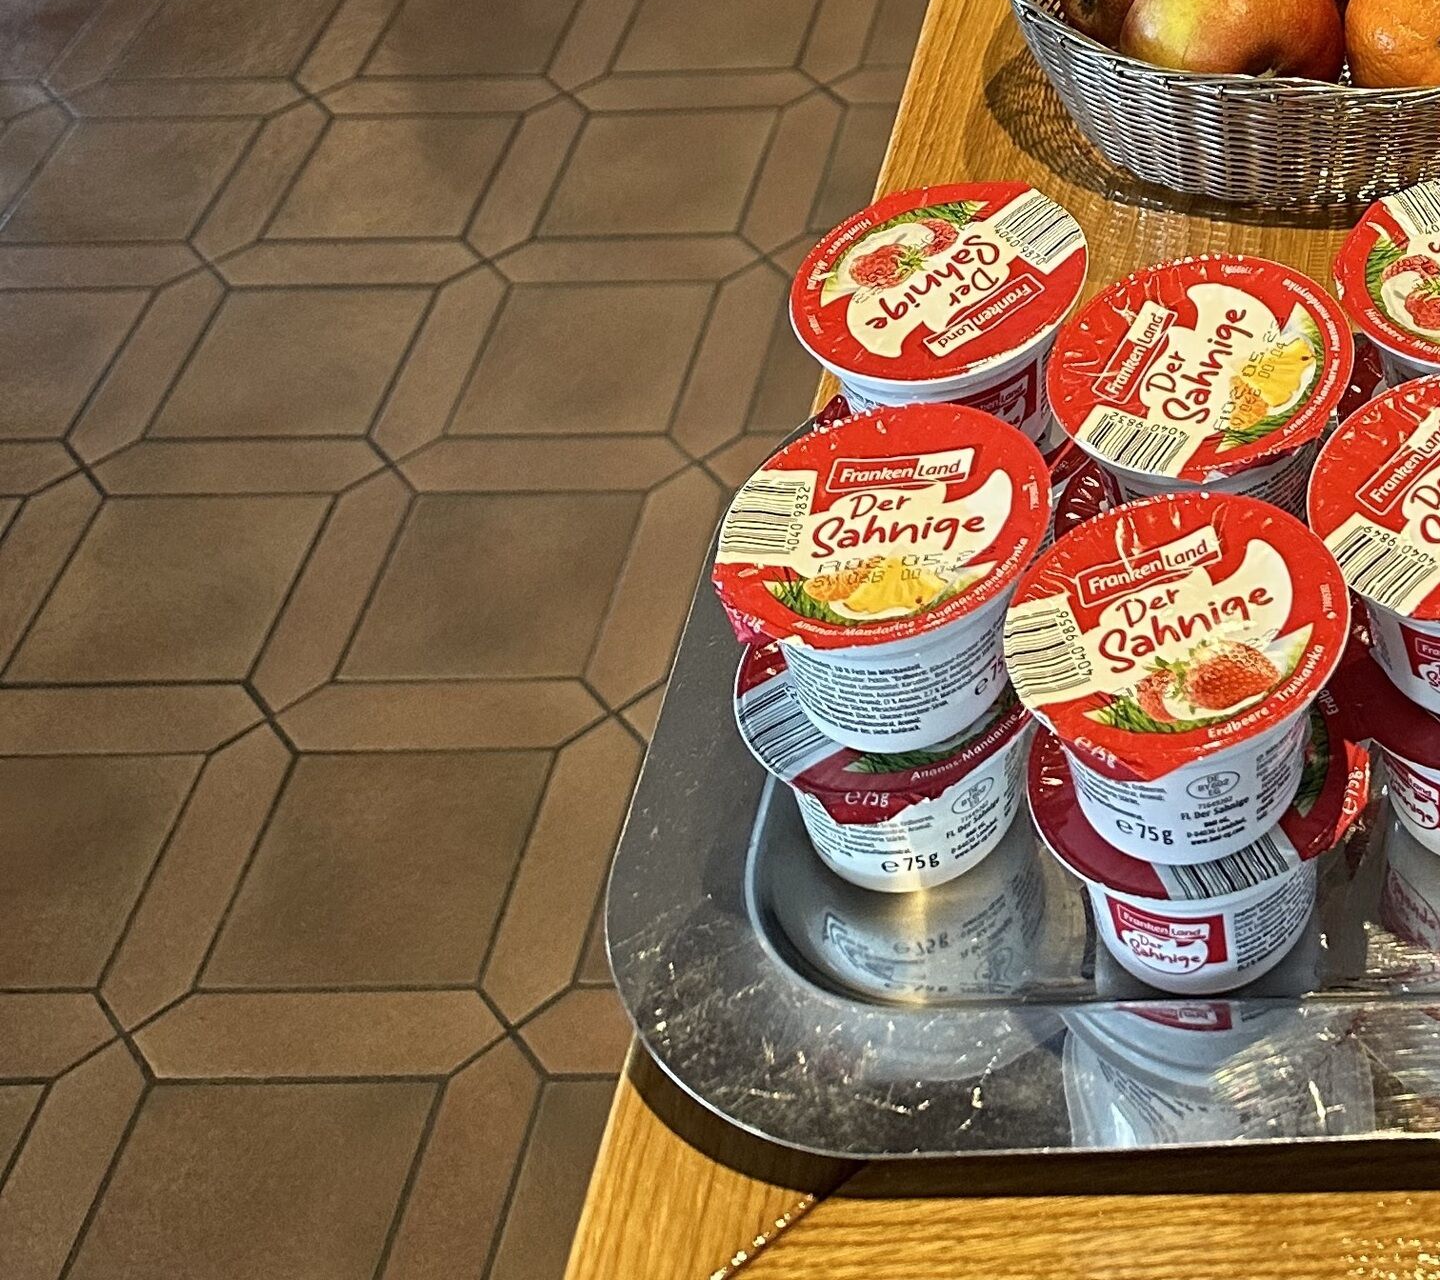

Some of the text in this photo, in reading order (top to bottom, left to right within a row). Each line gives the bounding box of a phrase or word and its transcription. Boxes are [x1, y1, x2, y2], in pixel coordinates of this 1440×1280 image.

[1019, 243, 1046, 265] 9870
[865, 234, 1000, 330] Sahnige
[949, 268, 1000, 307] Der
[1146, 351, 1187, 393] Der
[1162, 308, 1254, 424] Sahnige
[1109, 411, 1185, 438] 4040 9832
[786, 485, 811, 552] 4040 9832
[850, 493, 911, 520] Der
[811, 514, 985, 558] Sahnige
[1363, 526, 1436, 566] 4040 9849
[1116, 589, 1179, 628] Der
[1056, 610, 1093, 677] 4040 9856
[1098, 587, 1274, 674] Sahnige
[1207, 644, 1325, 739] Erdbeere Truskawka
[911, 712, 1018, 782] Ananas-Mandarine
[1129, 938, 1203, 968] Sahnige
[1139, 934, 1164, 949] Der
